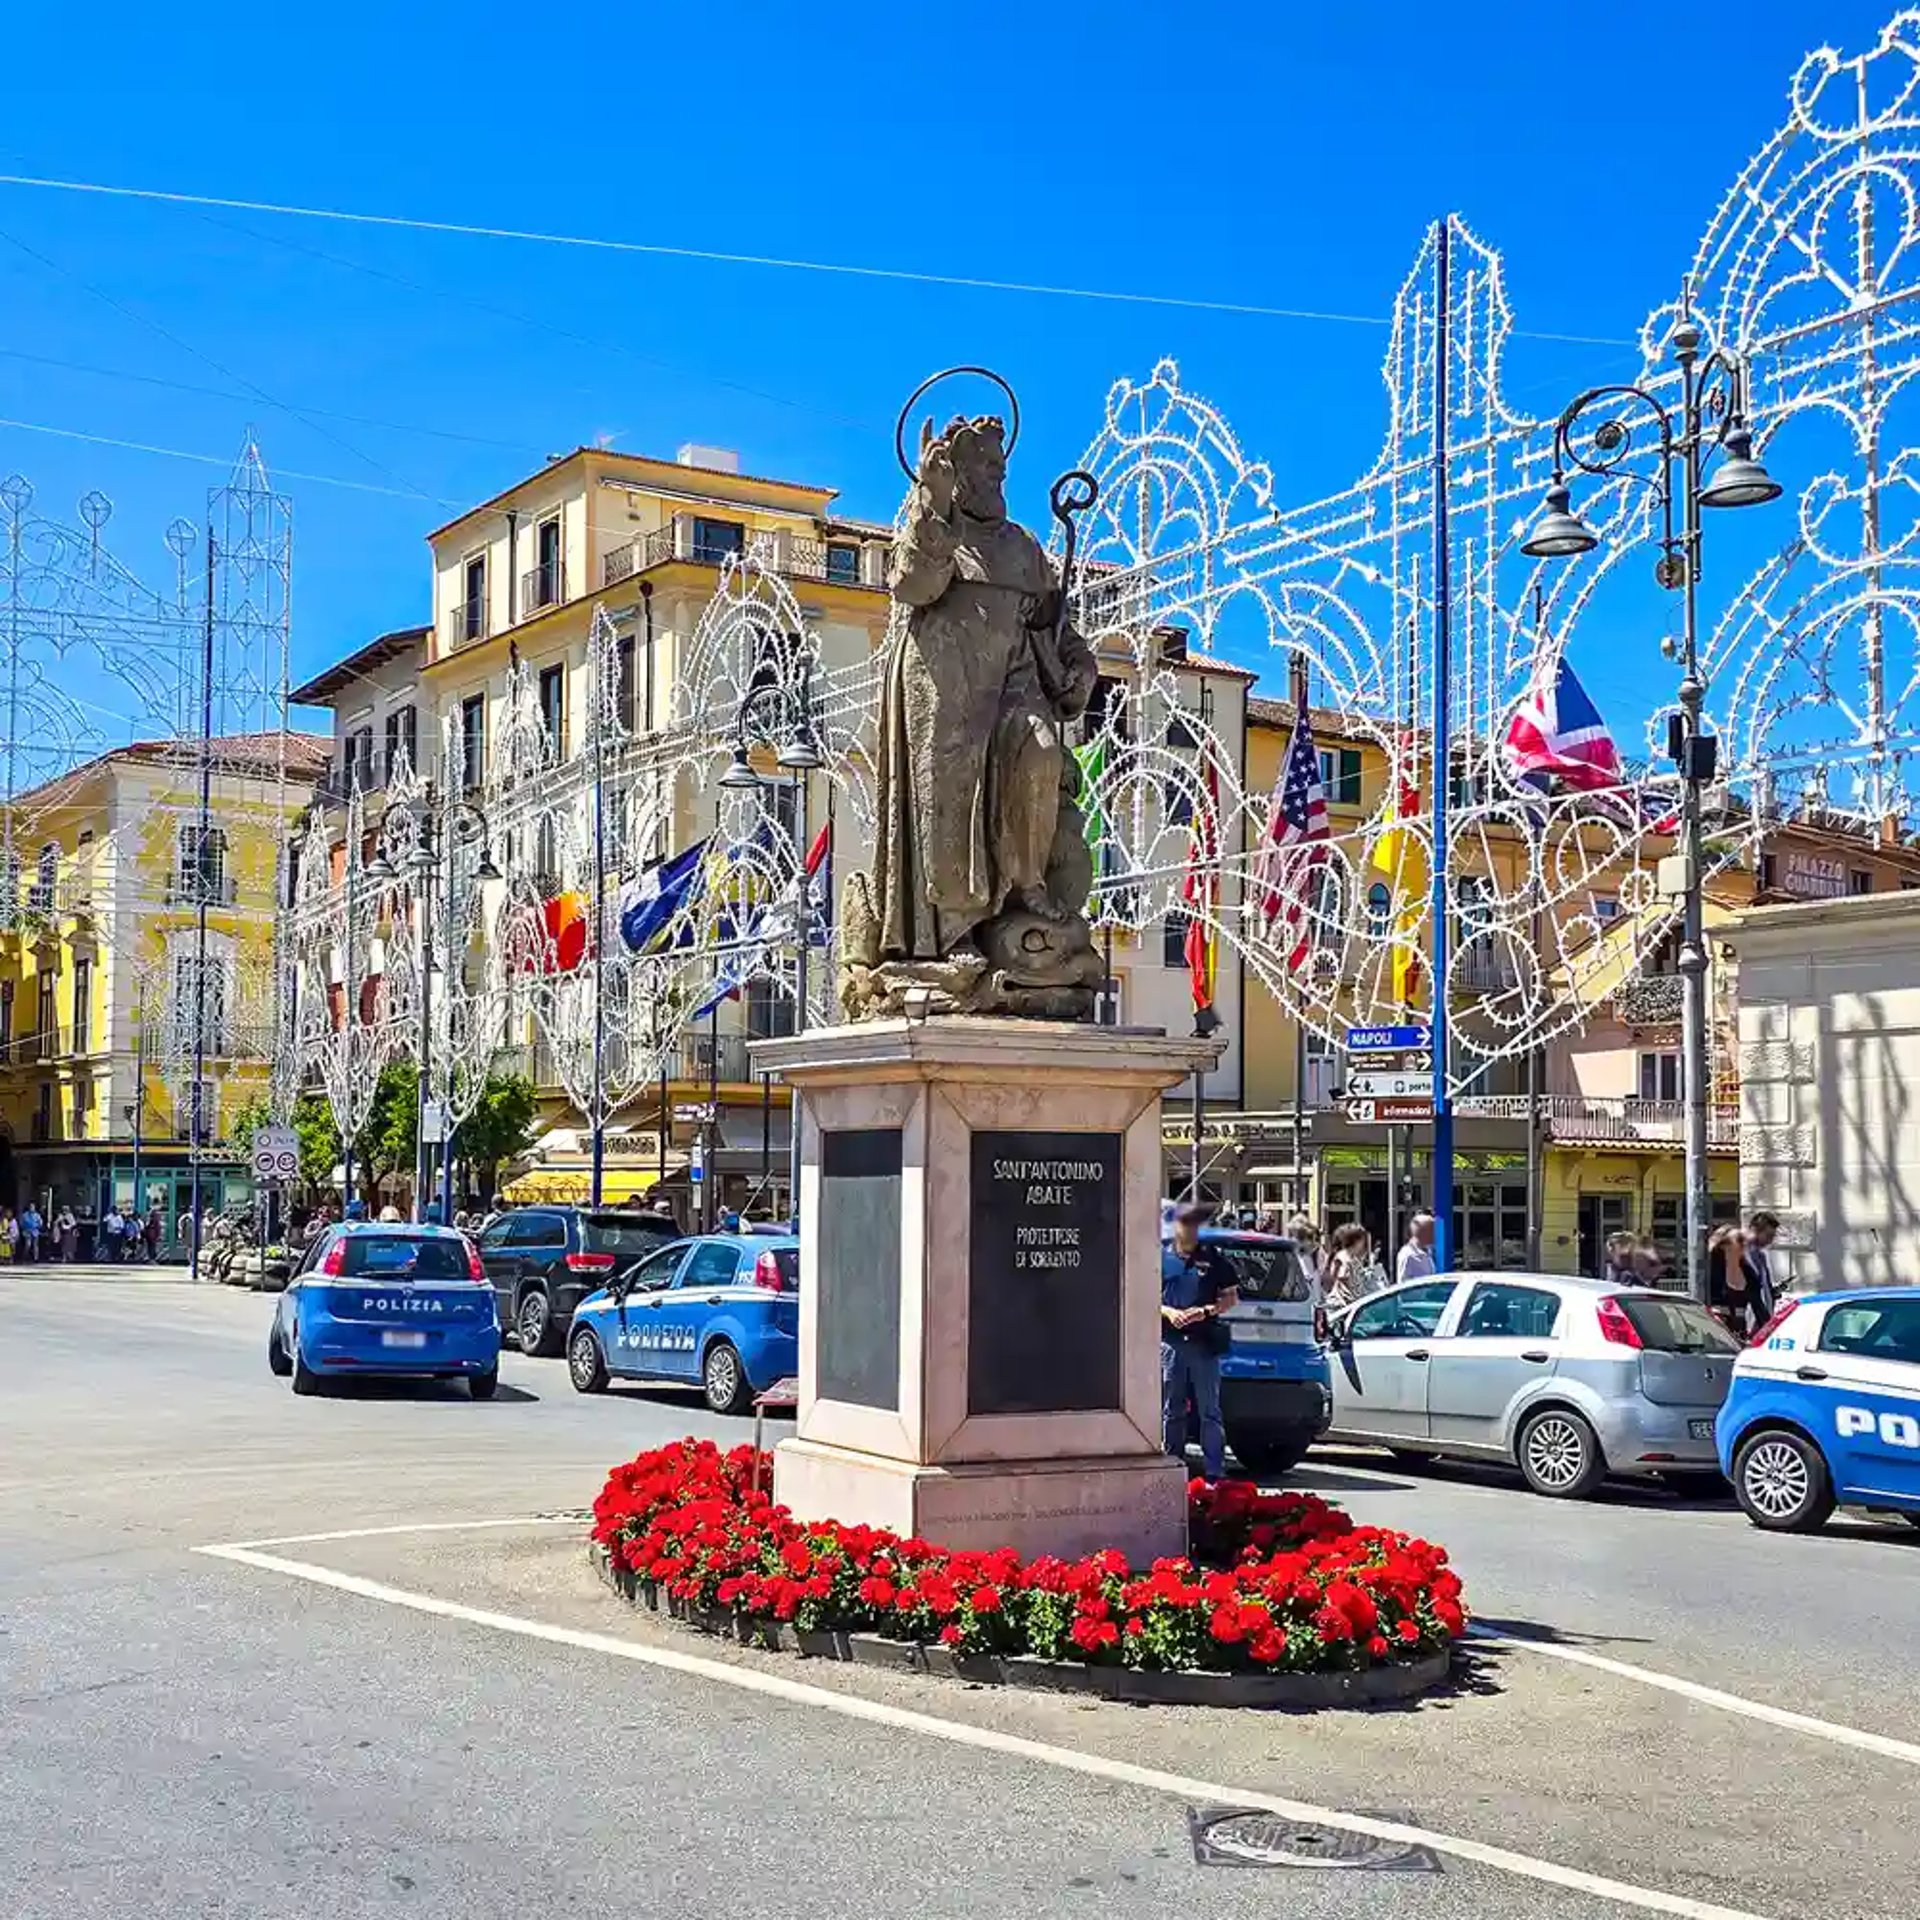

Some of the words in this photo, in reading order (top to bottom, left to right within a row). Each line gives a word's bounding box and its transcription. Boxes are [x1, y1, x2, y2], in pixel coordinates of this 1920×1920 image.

[1351, 1032, 1393, 1045] NAPOLI
[993, 1159, 1104, 1181] SANT'ANTONINO
[1026, 1185, 1072, 1205] ABATE
[1016, 1227, 1081, 1246] PROTETTORE
[1029, 1250, 1081, 1269] SORRENTO
[363, 1298, 443, 1312] POLIZIA
[617, 1323, 696, 1351] POLIZIA
[1767, 1337, 1796, 1351] 113
